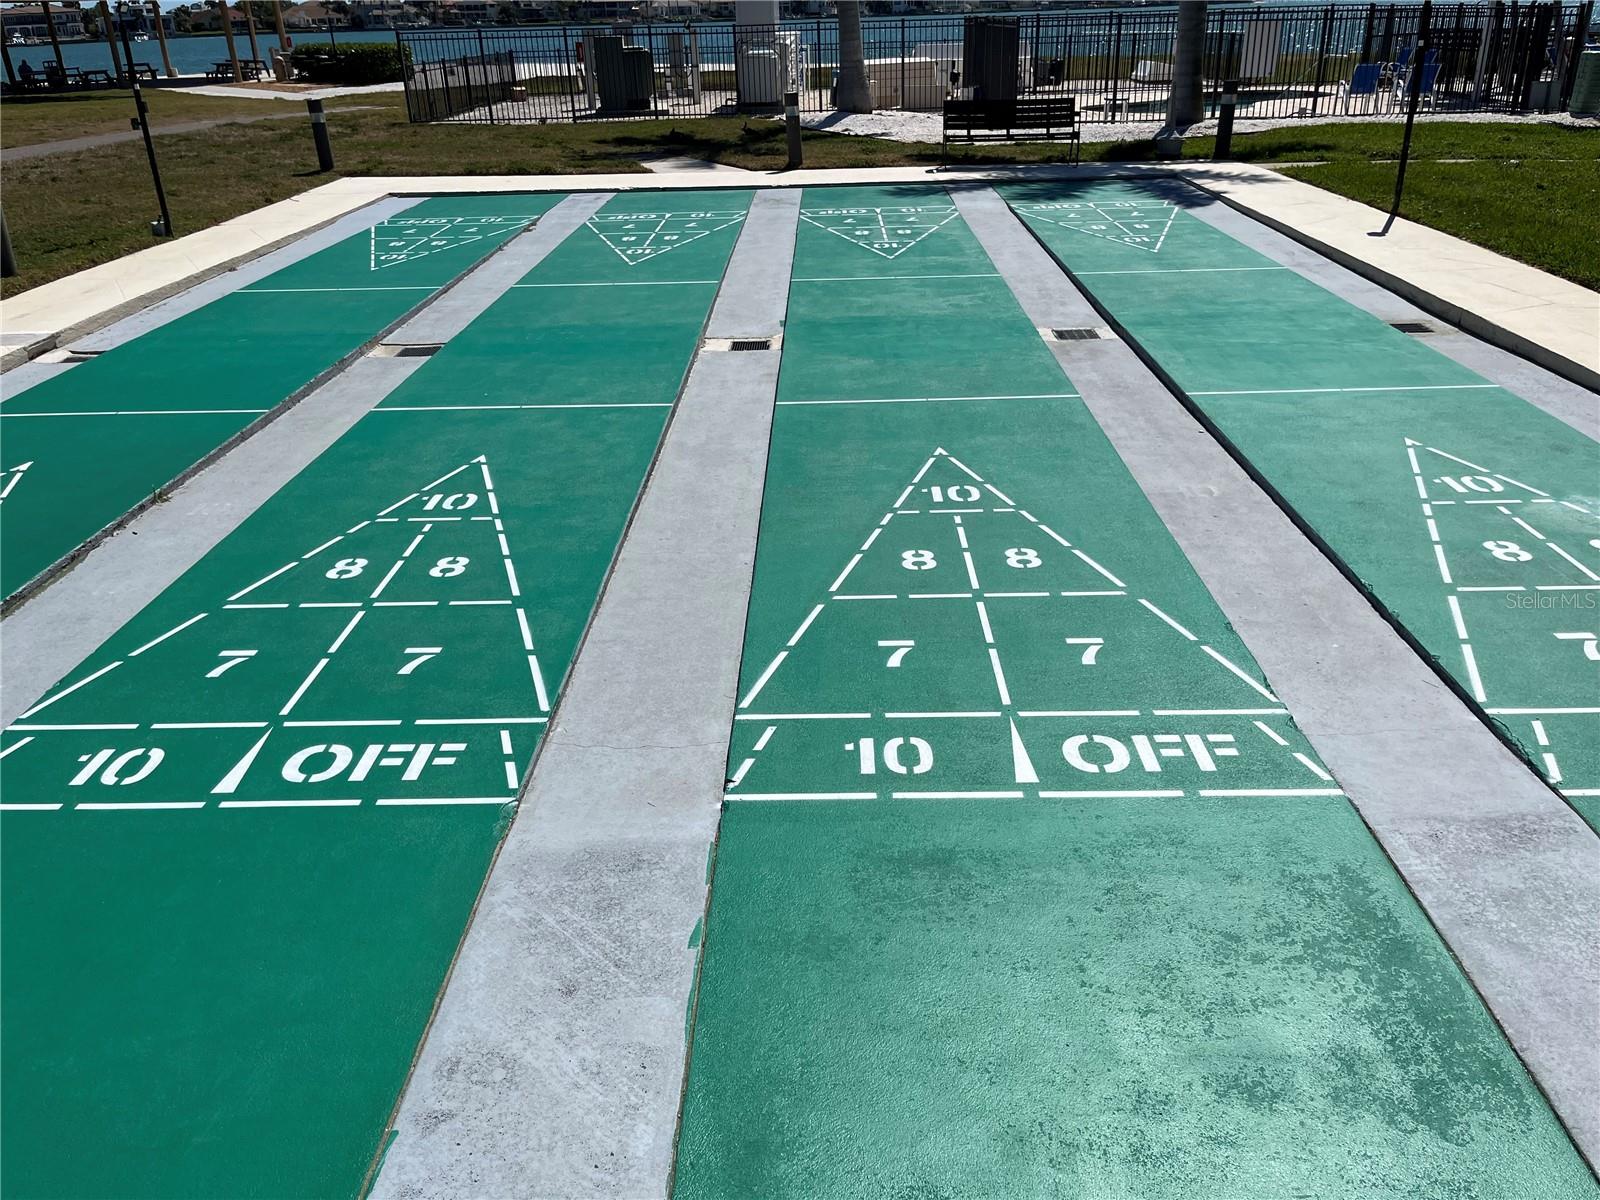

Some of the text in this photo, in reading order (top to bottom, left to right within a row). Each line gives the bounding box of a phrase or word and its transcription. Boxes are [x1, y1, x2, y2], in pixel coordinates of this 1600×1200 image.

[922, 485, 981, 502] 10
[1432, 475, 1505, 493] 10
[422, 493, 478, 511] 10
[902, 549, 937, 570] 8
[1005, 548, 1042, 569] 8
[1483, 540, 1533, 562] 8
[326, 558, 369, 579] 8
[430, 556, 470, 577] 8
[397, 647, 443, 675] 7
[878, 639, 915, 668] 7
[1066, 637, 1104, 665] 7
[206, 649, 258, 678] 7
[69, 743, 467, 786] 10 OFF
[844, 733, 1239, 775] 10 OFF
